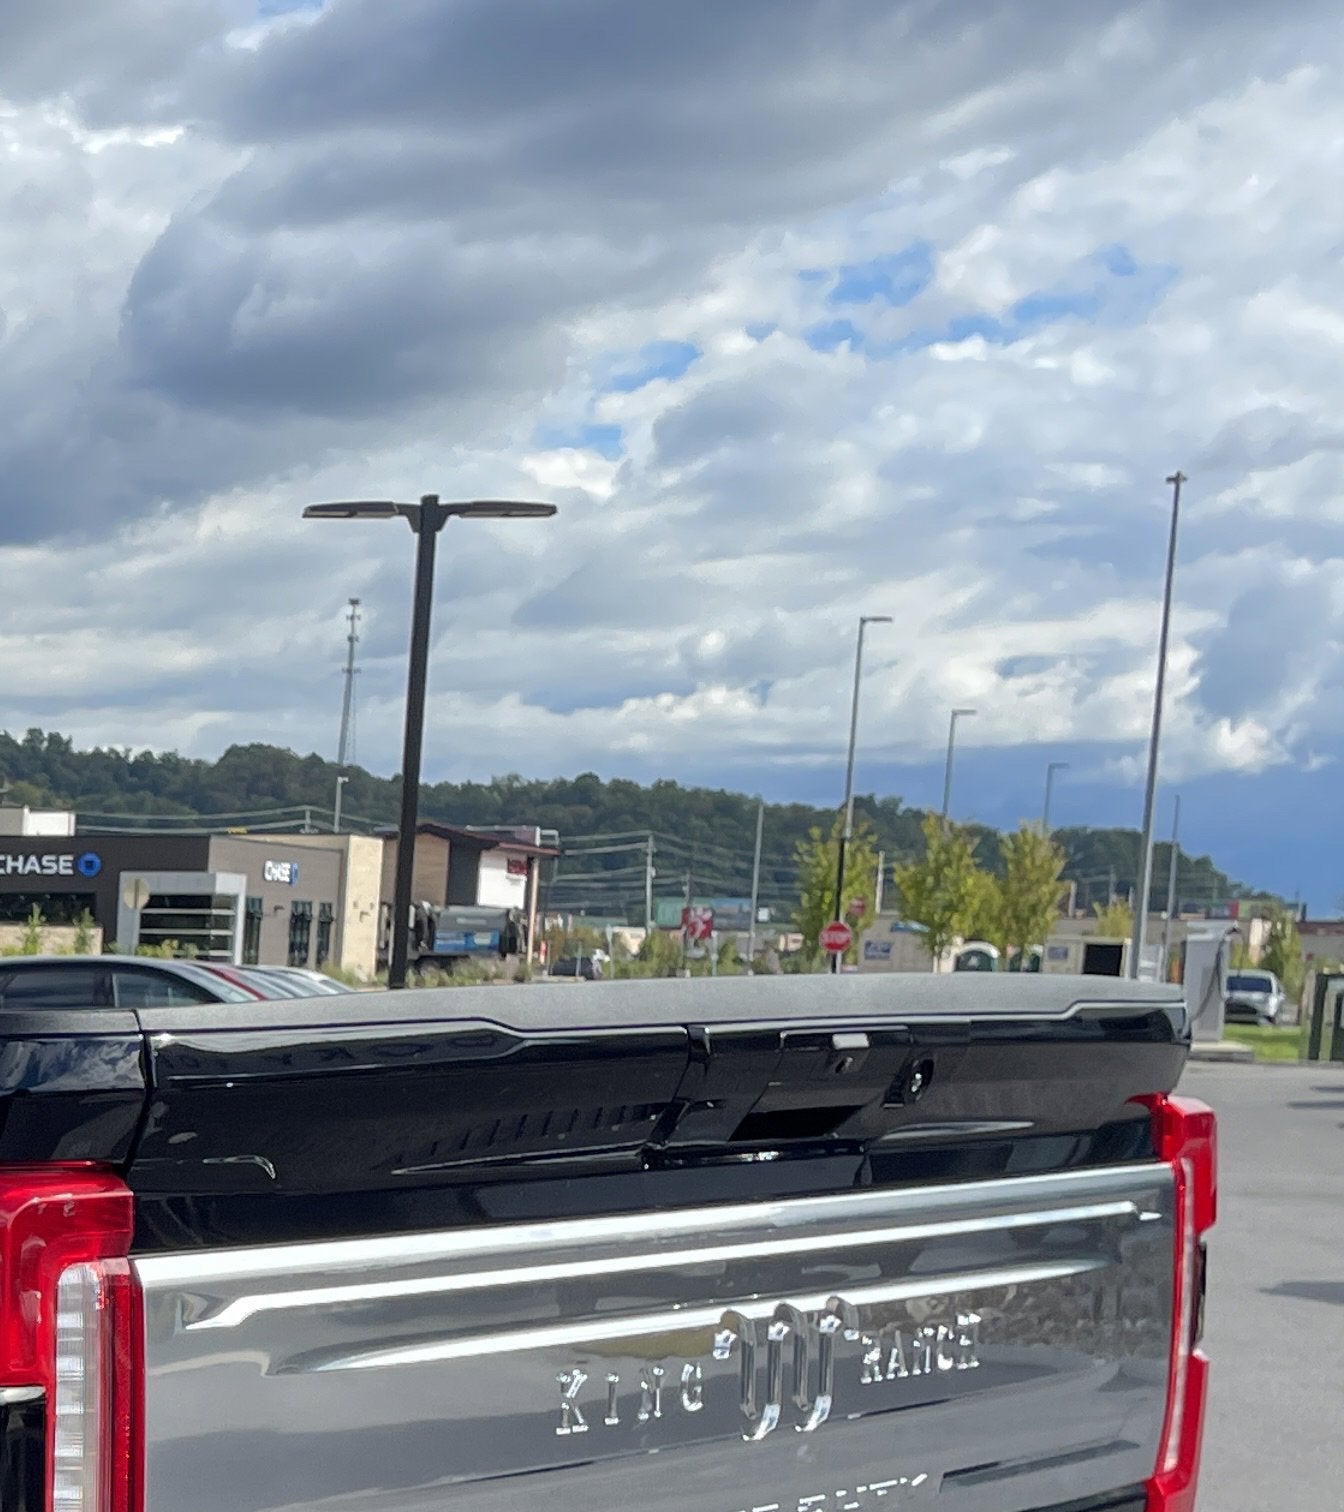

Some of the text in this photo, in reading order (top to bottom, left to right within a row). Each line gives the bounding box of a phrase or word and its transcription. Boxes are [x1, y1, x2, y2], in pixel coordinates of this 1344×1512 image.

[264, 861, 291, 882] CHASE
[555, 1312, 983, 1436] KING RANCH
